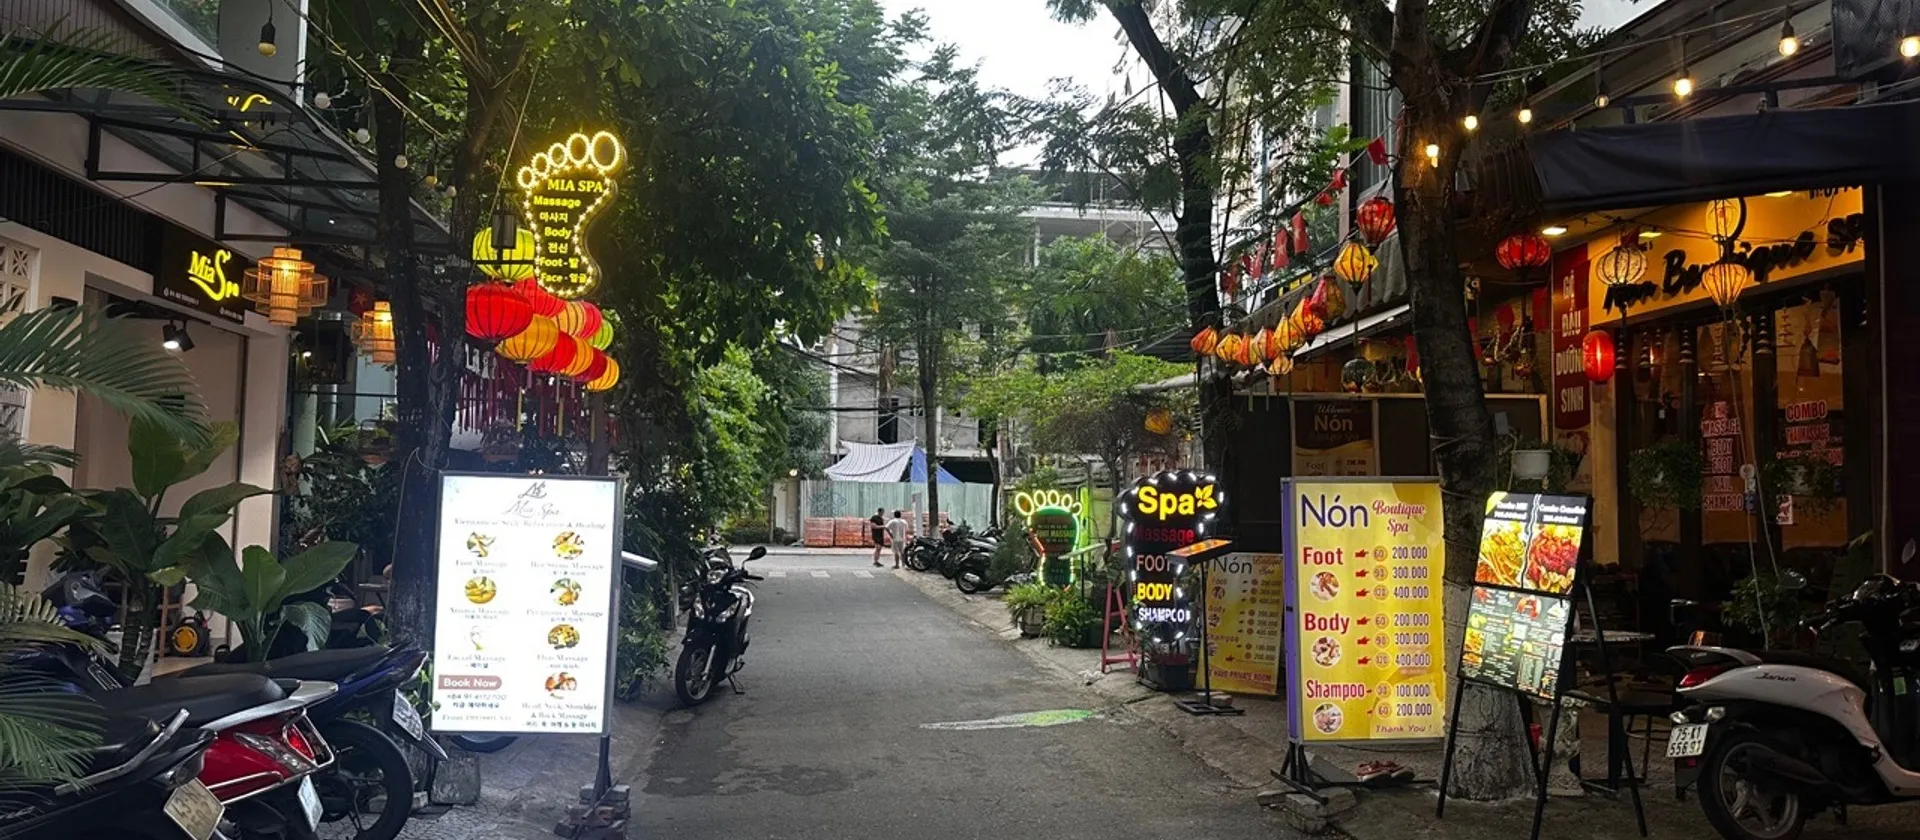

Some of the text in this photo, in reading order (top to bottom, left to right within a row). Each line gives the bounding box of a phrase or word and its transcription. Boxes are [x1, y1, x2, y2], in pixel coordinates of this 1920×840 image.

[547, 178, 603, 193] MIA SPA
[533, 195, 581, 209] Massage
[539, 212, 568, 224] 마사지
[544, 226, 572, 239] Body
[187, 250, 216, 284] Mia
[539, 257, 562, 267] Foot
[540, 273, 563, 283] Face
[1561, 386, 1584, 413] SINH
[1786, 401, 1827, 421] COMBO
[1314, 414, 1353, 431] Nón
[1138, 486, 1195, 520] Spa
[1301, 494, 1425, 528] Nón Boutique
[1387, 518, 1409, 536] Spa
[1133, 528, 1195, 546] Massage
[1136, 554, 1171, 571] FOOT
[1303, 547, 1344, 565] Foot
[1392, 547, 1428, 559] 200.000
[1213, 557, 1252, 574] Nón
[1393, 567, 1428, 579] 300.000
[1137, 583, 1173, 601] BODY
[1393, 587, 1429, 598] 400.000
[1304, 612, 1350, 635] Body
[1394, 613, 1430, 626] 200.000
[1395, 632, 1429, 645] 300.000
[1395, 654, 1431, 666] 400.000
[443, 678, 498, 688] Book Now
[1753, 672, 1796, 682] Janus
[1306, 680, 1365, 701] Shampoo
[1396, 684, 1430, 697] 100.000
[1396, 703, 1432, 716] 200.000
[1376, 725, 1405, 733] Thank
[1408, 725, 1426, 733] You
